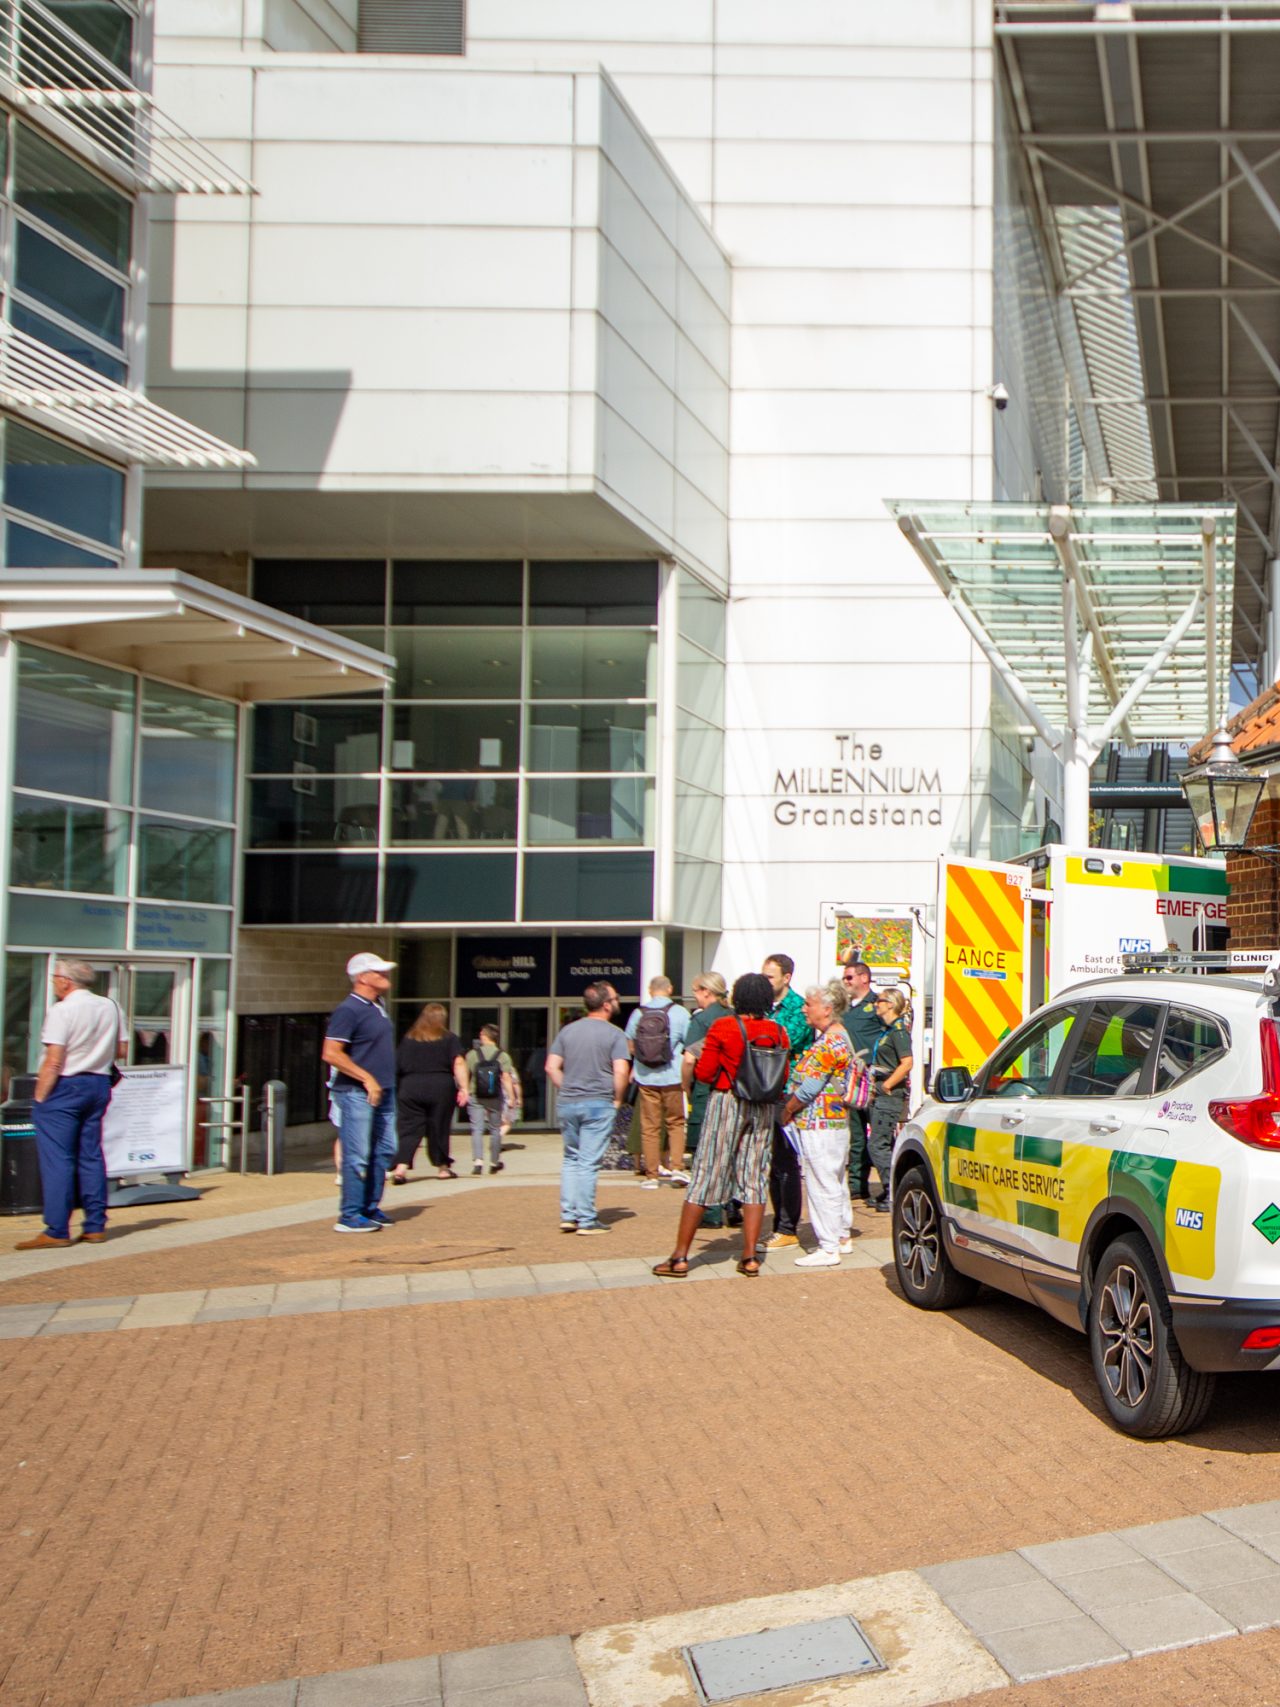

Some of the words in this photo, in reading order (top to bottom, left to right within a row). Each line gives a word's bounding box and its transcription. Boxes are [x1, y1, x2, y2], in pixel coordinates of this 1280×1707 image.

[835, 732, 883, 761] The
[774, 767, 942, 793] MILLENNIUM
[774, 797, 942, 826] Grandstand
[1007, 874, 1024, 885] 927
[1156, 899, 1227, 919] EMERGE
[1120, 939, 1150, 953] NHS
[1085, 954, 1102, 964] East
[1105, 955, 1115, 964] of
[570, 966, 610, 975] DOUBLE
[612, 966, 632, 975] BAR
[1070, 964, 1118, 975] Ambulance
[957, 1158, 990, 1184] URGENT
[992, 1165, 1020, 1190] CARE
[1021, 1171, 1065, 1201] SERVICE
[1176, 1208, 1204, 1230] NHS
